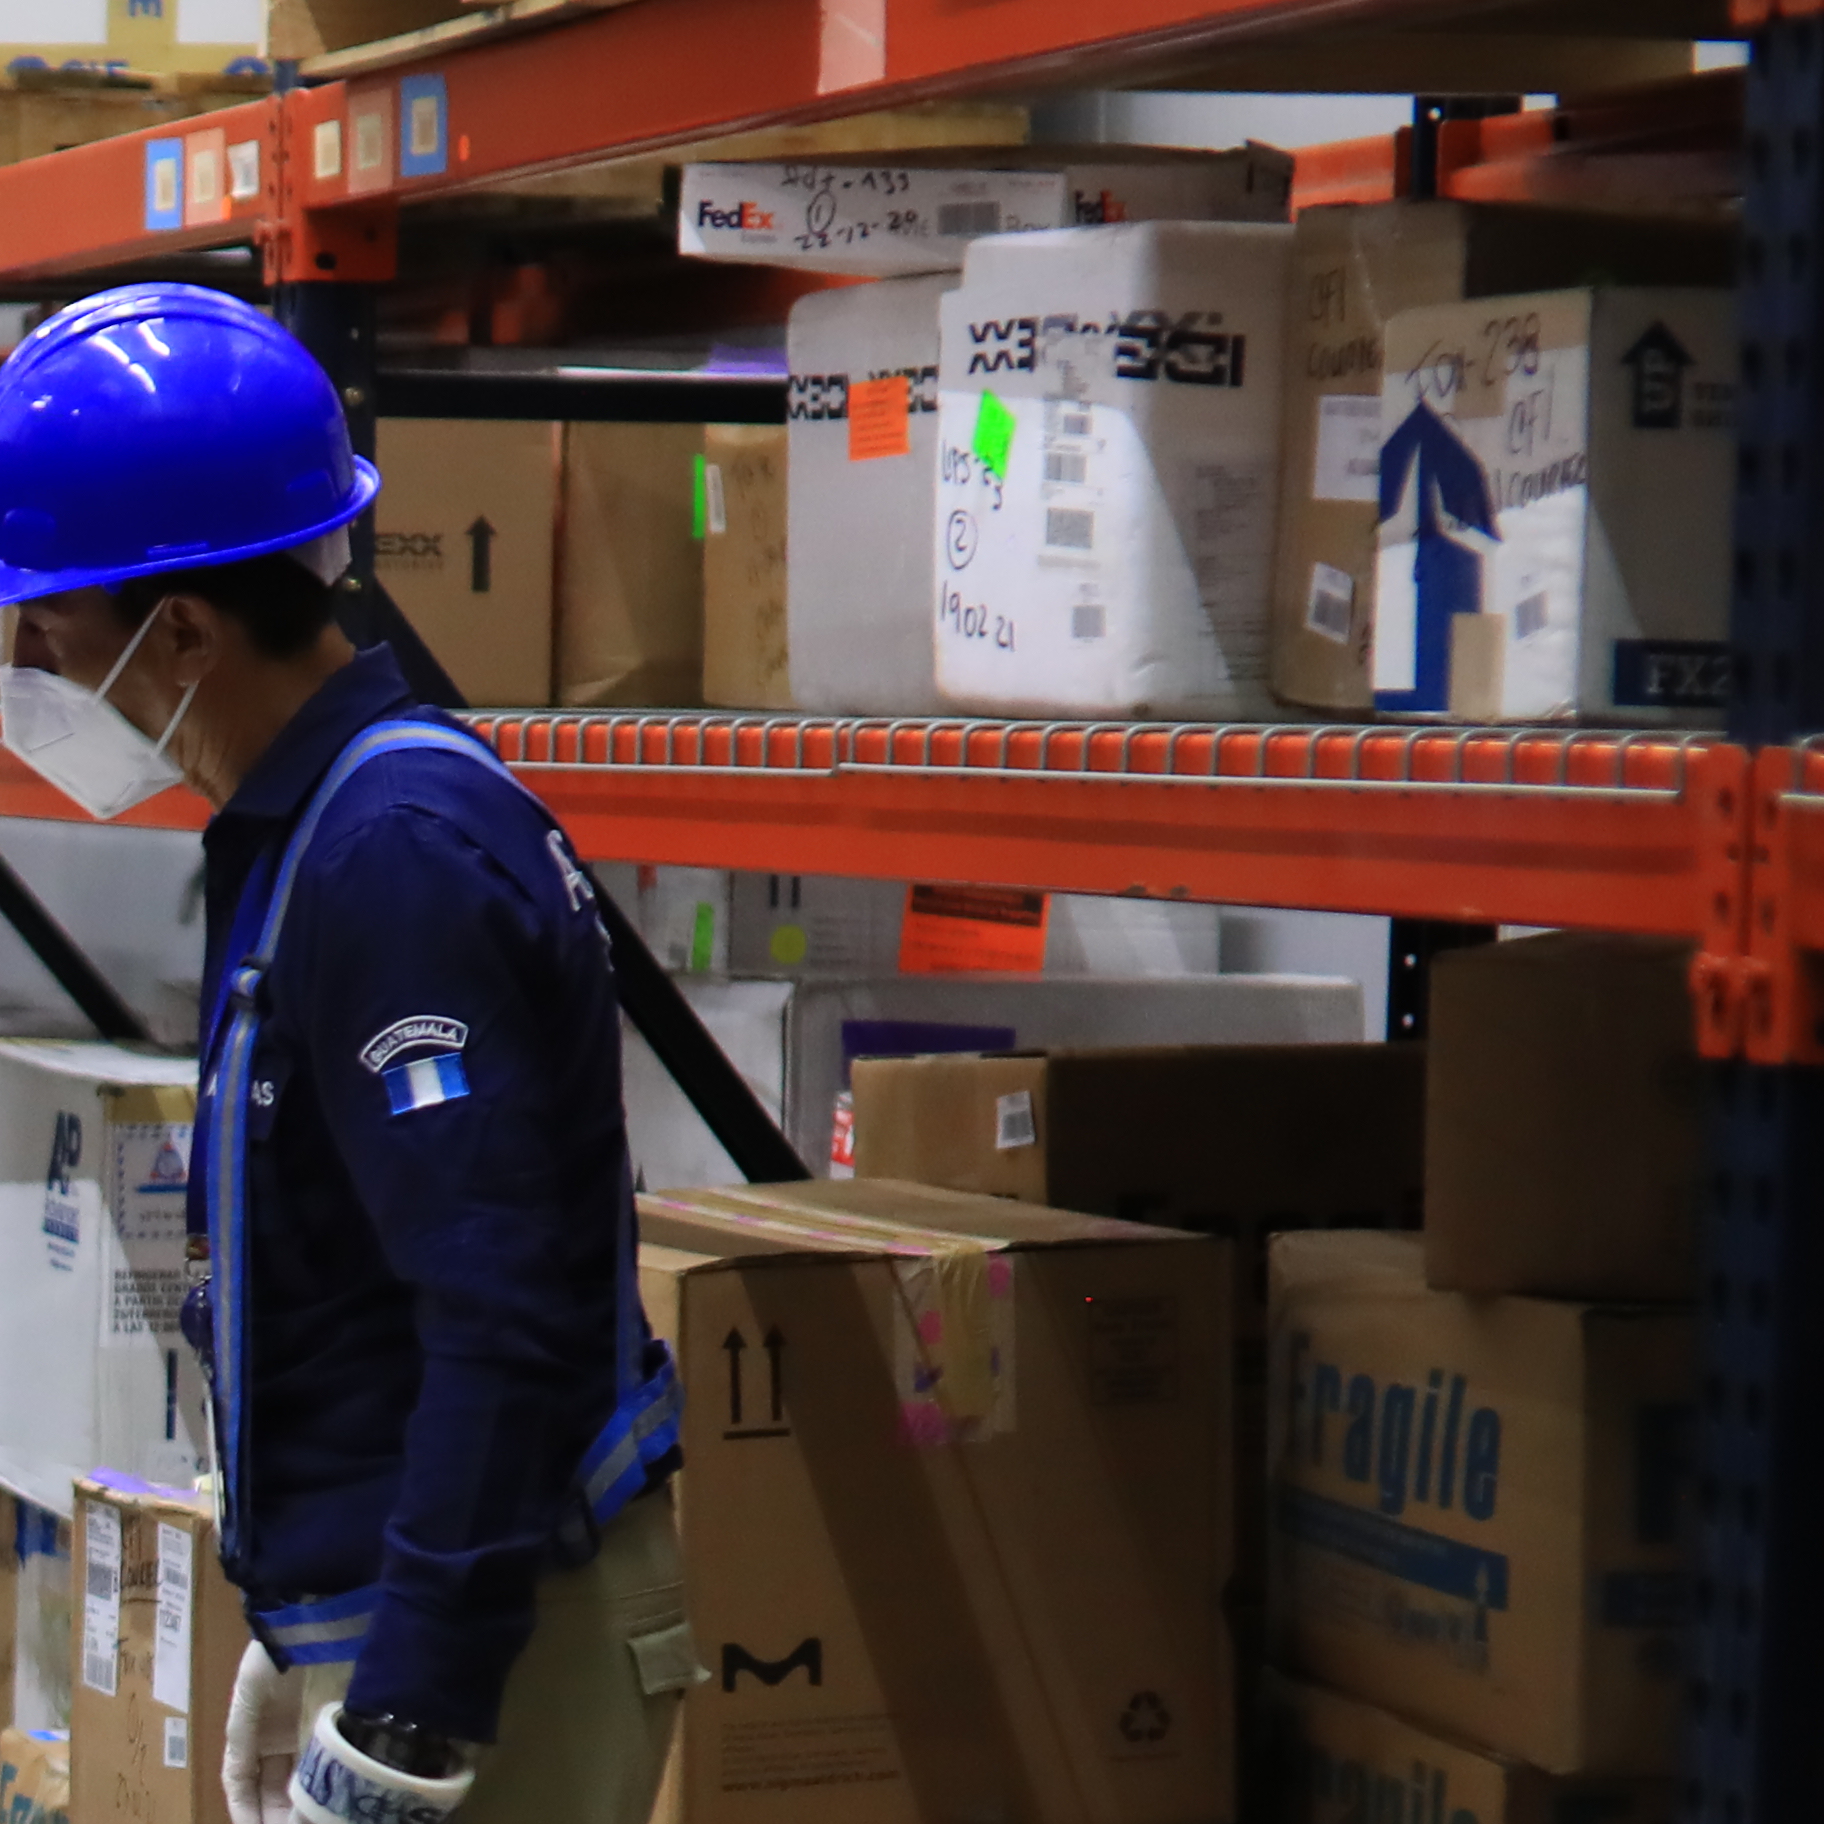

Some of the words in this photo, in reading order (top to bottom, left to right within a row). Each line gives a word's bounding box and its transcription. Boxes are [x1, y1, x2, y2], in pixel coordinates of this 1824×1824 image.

[699, 202, 774, 230] FedEx
[369, 1023, 458, 1063] GUATEMALA
[1289, 1330, 1501, 1521] Fragile
